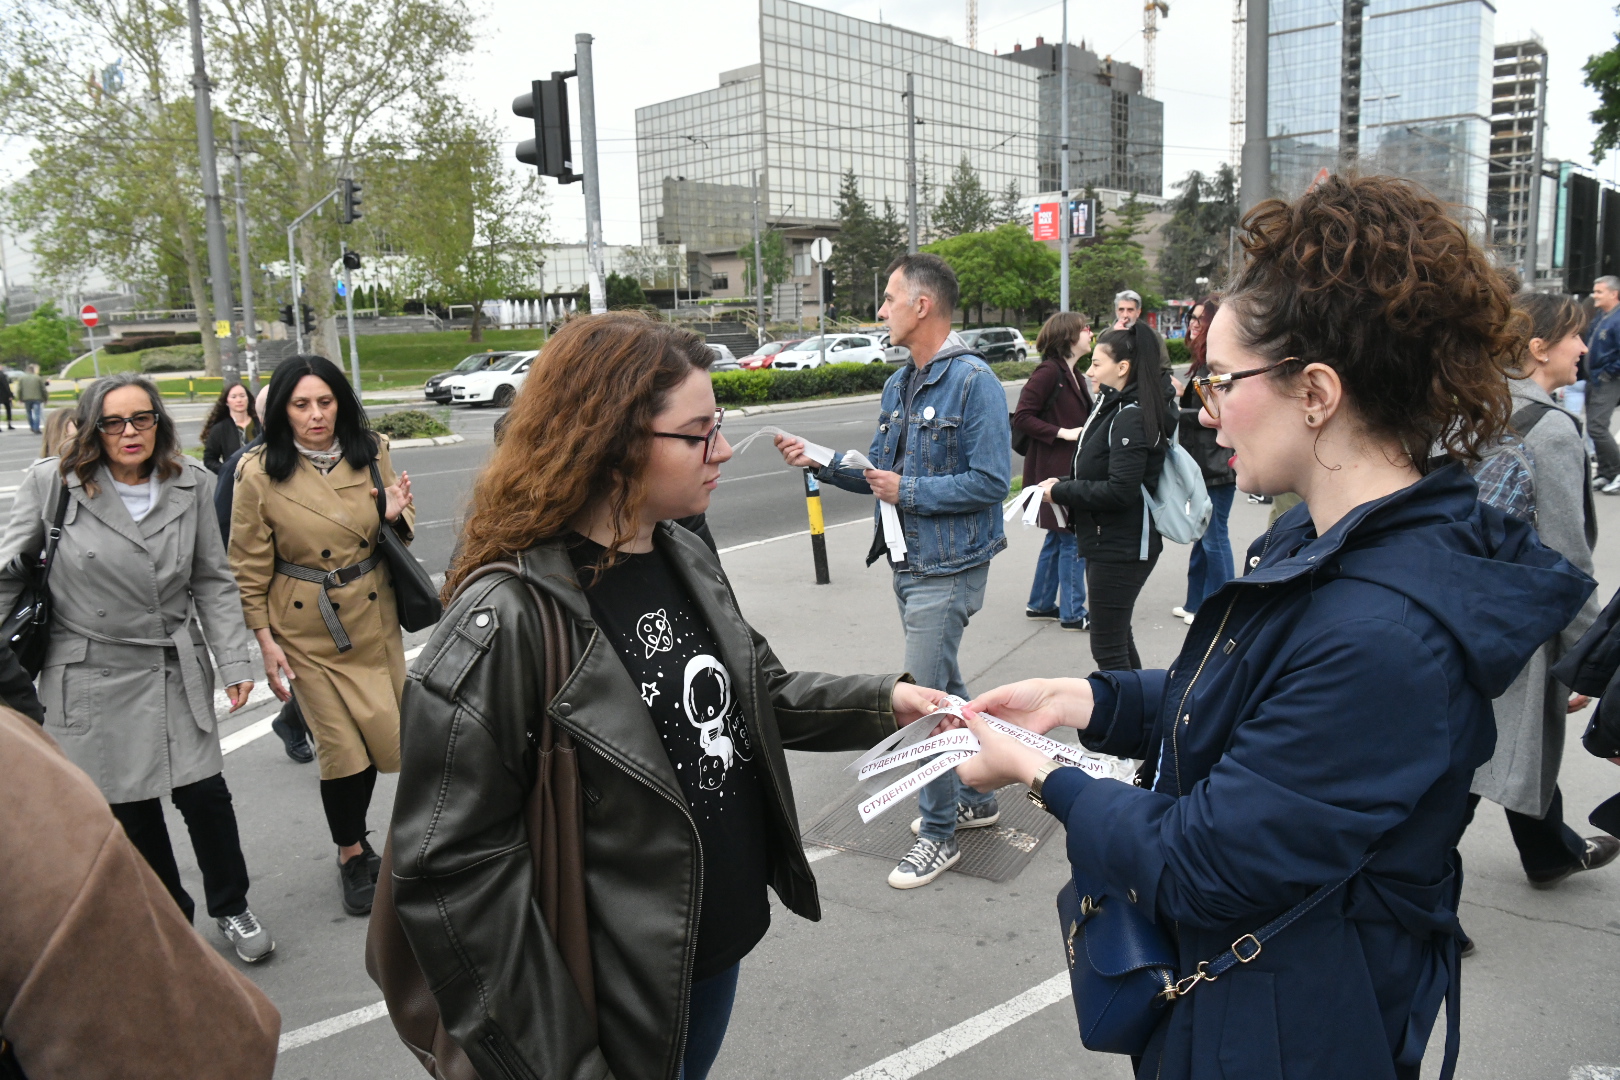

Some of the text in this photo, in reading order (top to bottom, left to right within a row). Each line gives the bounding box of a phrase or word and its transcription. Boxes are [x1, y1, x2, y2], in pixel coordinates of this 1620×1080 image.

[861, 735, 969, 774] СТУДЕНТИ ПОБЕЂУЈУ!
[863, 750, 978, 814] СТУДЕНТИ ПОБЕЂУЈУ
